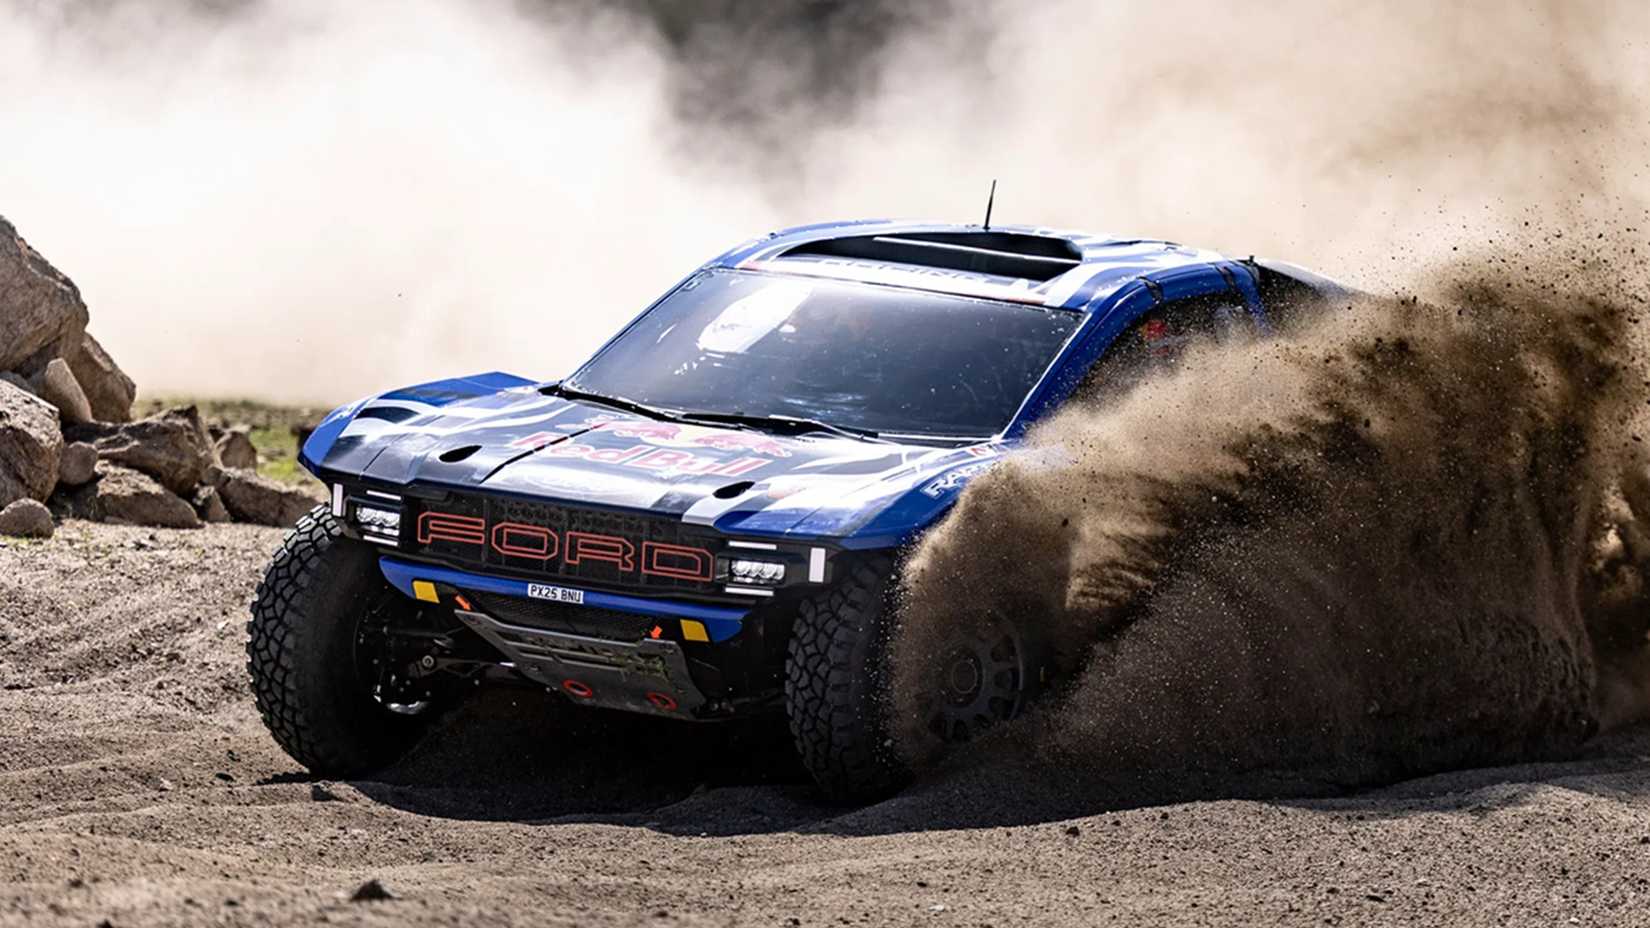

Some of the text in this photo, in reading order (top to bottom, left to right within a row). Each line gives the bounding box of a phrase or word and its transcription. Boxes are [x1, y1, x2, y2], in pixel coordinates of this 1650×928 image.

[418, 512, 714, 582] FORD
[530, 584, 581, 602] PX25 BNU
